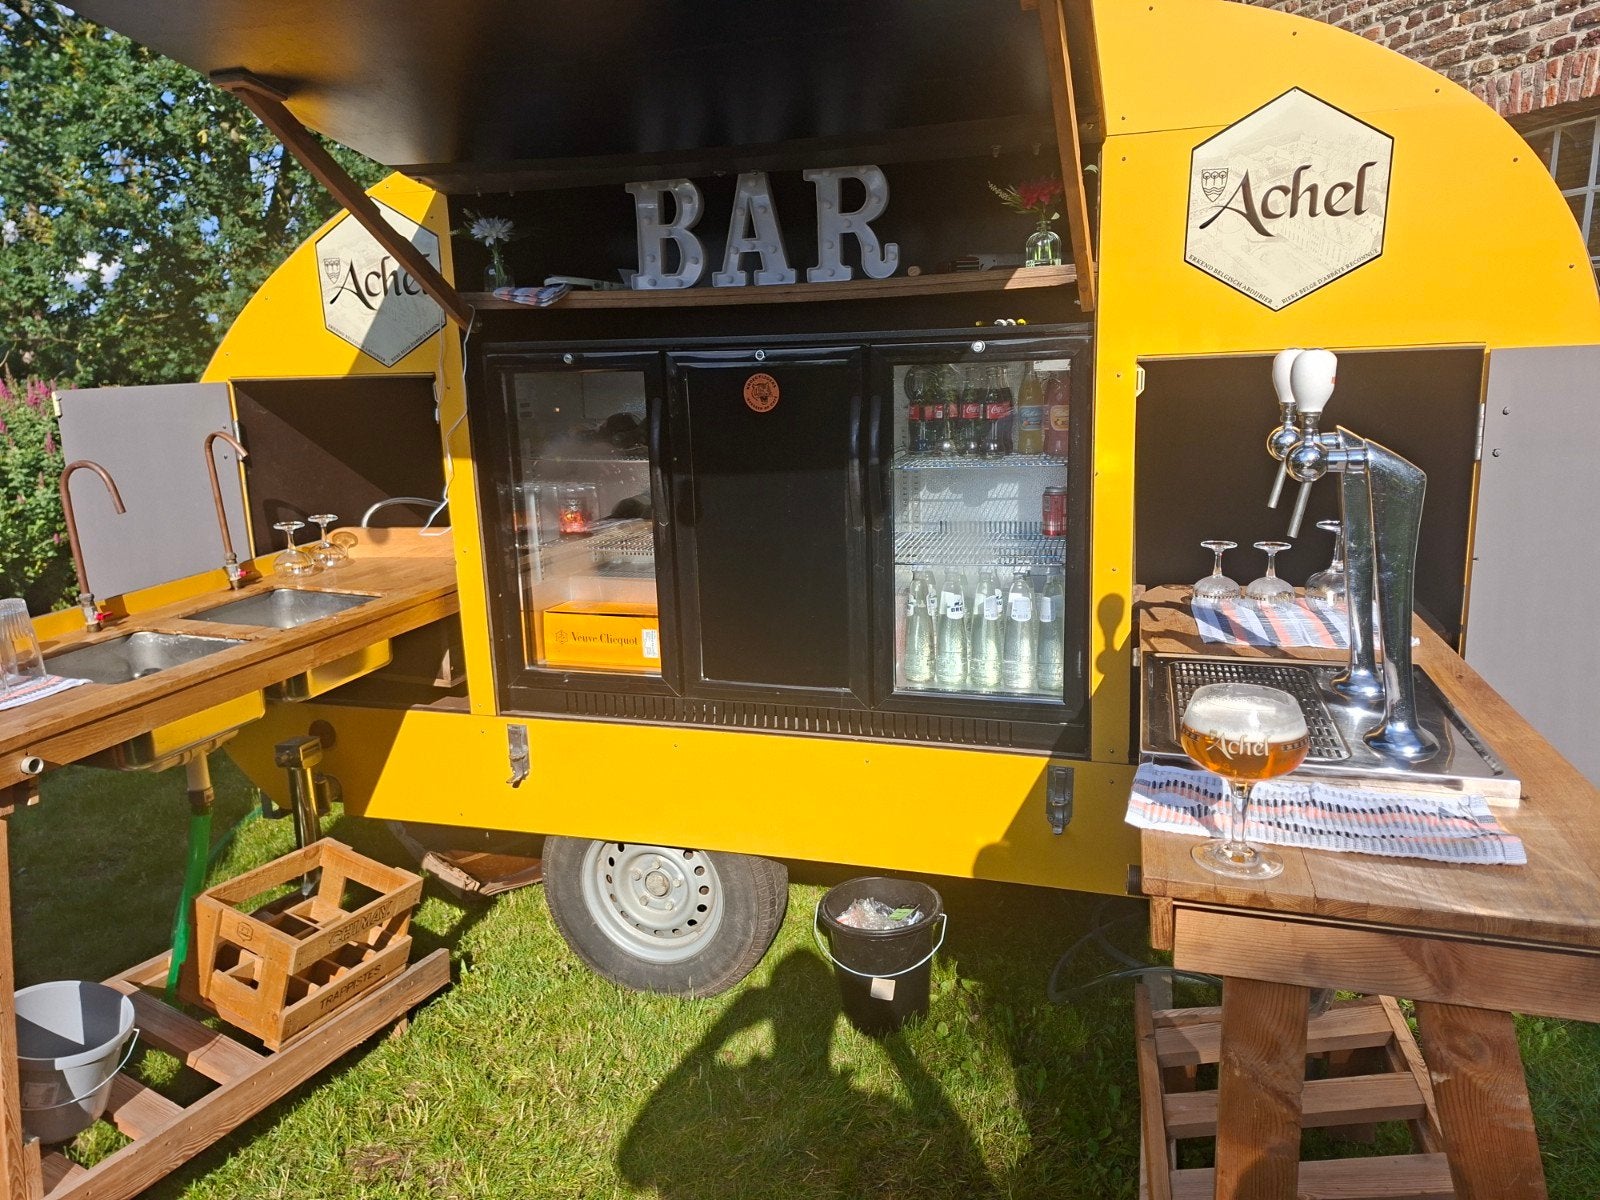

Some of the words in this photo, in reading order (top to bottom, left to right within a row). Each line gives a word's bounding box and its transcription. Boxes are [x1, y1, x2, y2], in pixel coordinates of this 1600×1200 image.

[1199, 161, 1378, 237] Achel
[625, 164, 899, 290] BAR
[1188, 254, 1214, 272] ERKEND
[1213, 268, 1243, 288] BELGISCH
[1242, 285, 1273, 305] ABDIJBIER
[1299, 281, 1317, 294] BELGE
[1345, 247, 1379, 269] RECONNUE
[571, 631, 598, 643] Veuve
[599, 632, 638, 646] Clicquot
[1206, 731, 1270, 760] Achel
[328, 900, 393, 948] CHIMAY
[320, 964, 382, 1009] TRAPPISTES
